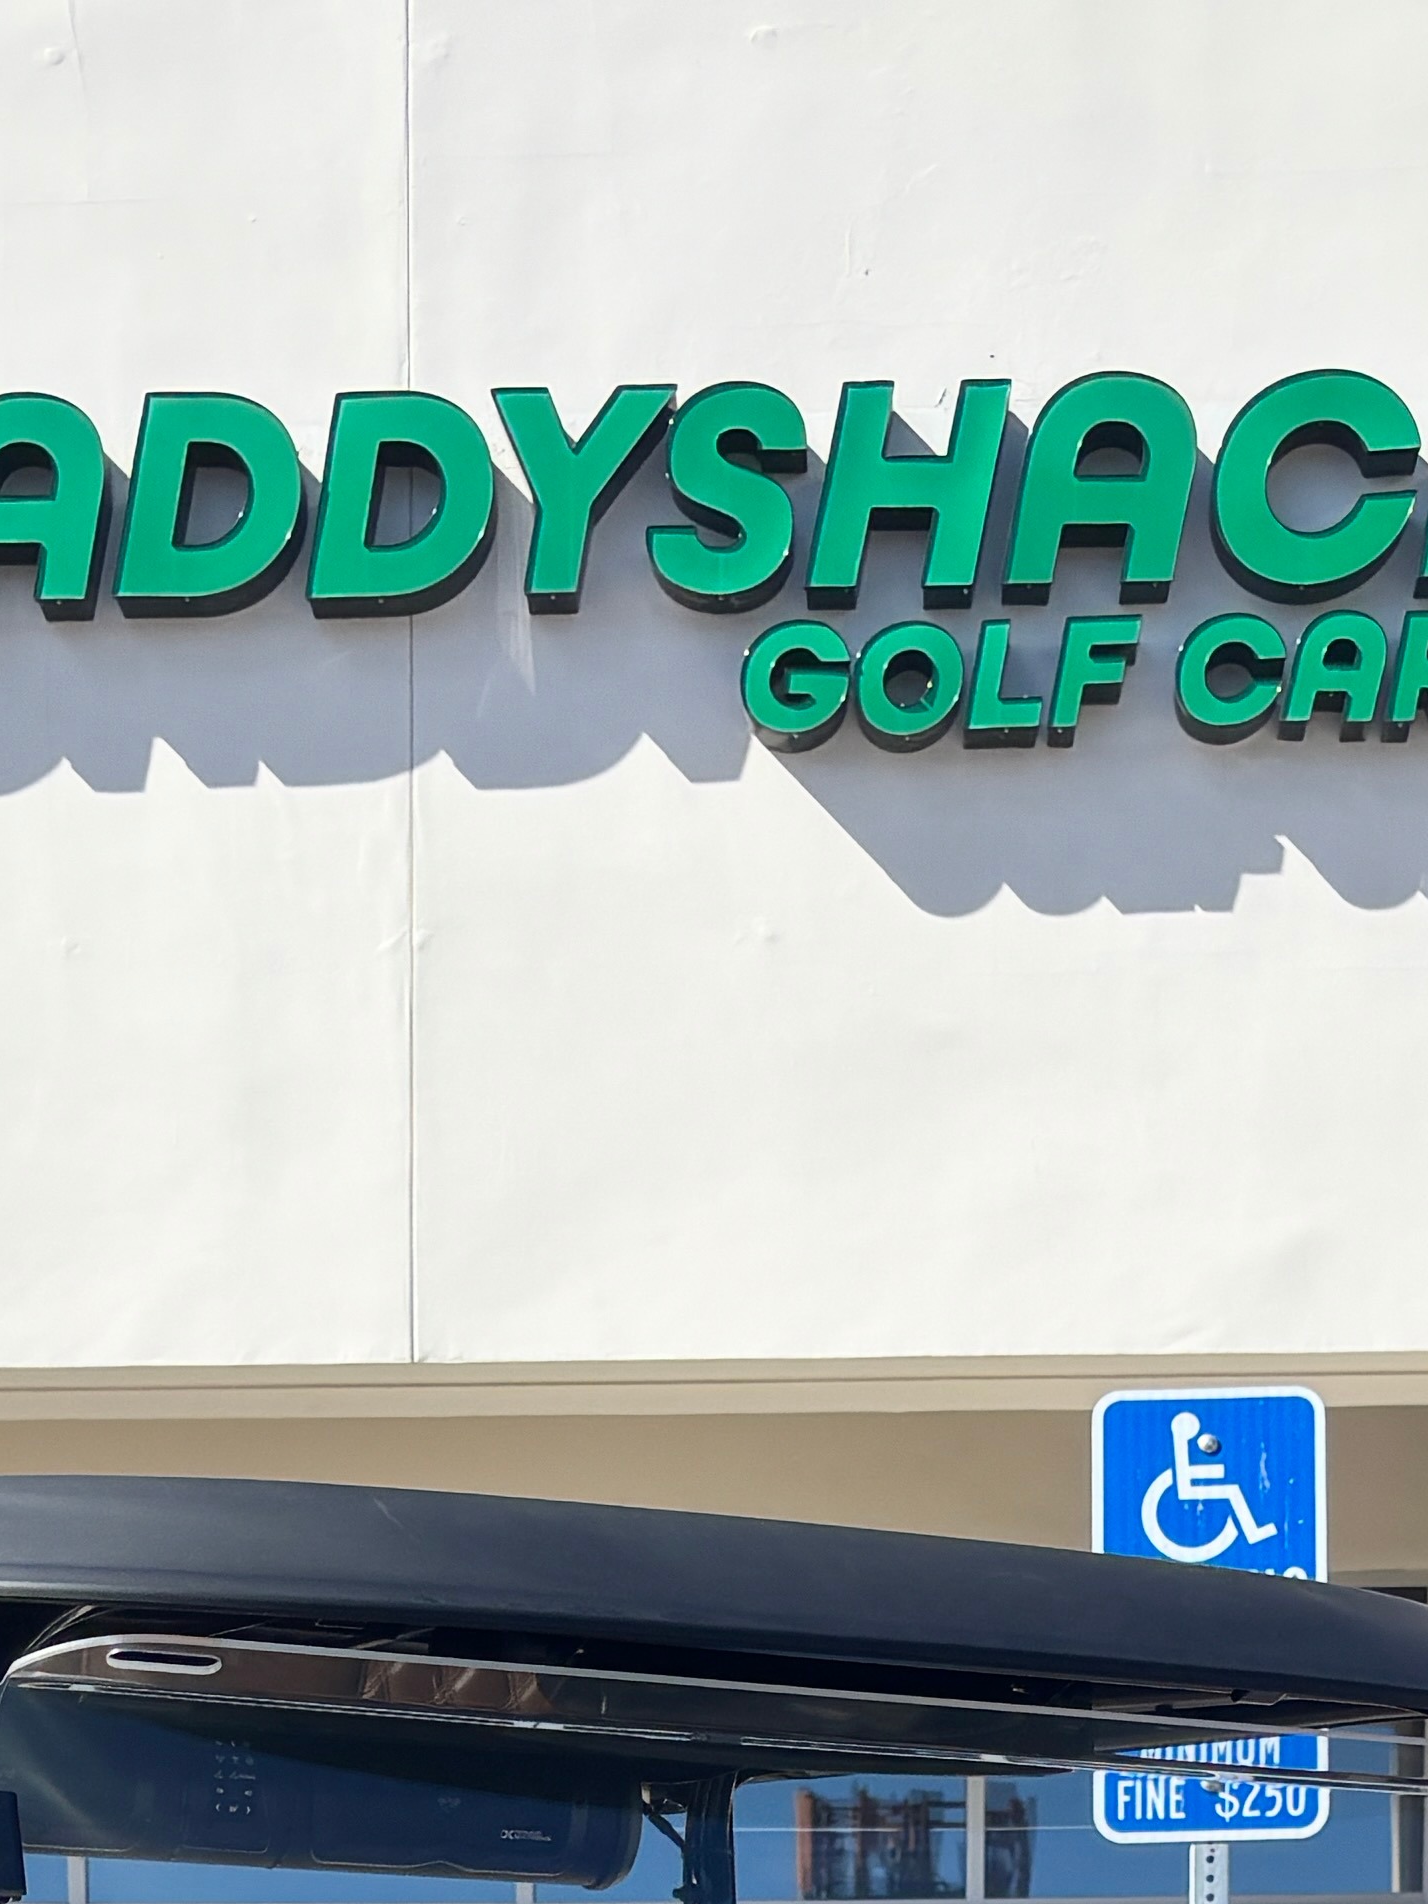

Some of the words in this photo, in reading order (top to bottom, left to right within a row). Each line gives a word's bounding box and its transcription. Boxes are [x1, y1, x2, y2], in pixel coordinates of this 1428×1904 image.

[740, 613, 1144, 742] GOLF
[1117, 1779, 1186, 1821] FINE
[1213, 1780, 1307, 1823] $250
